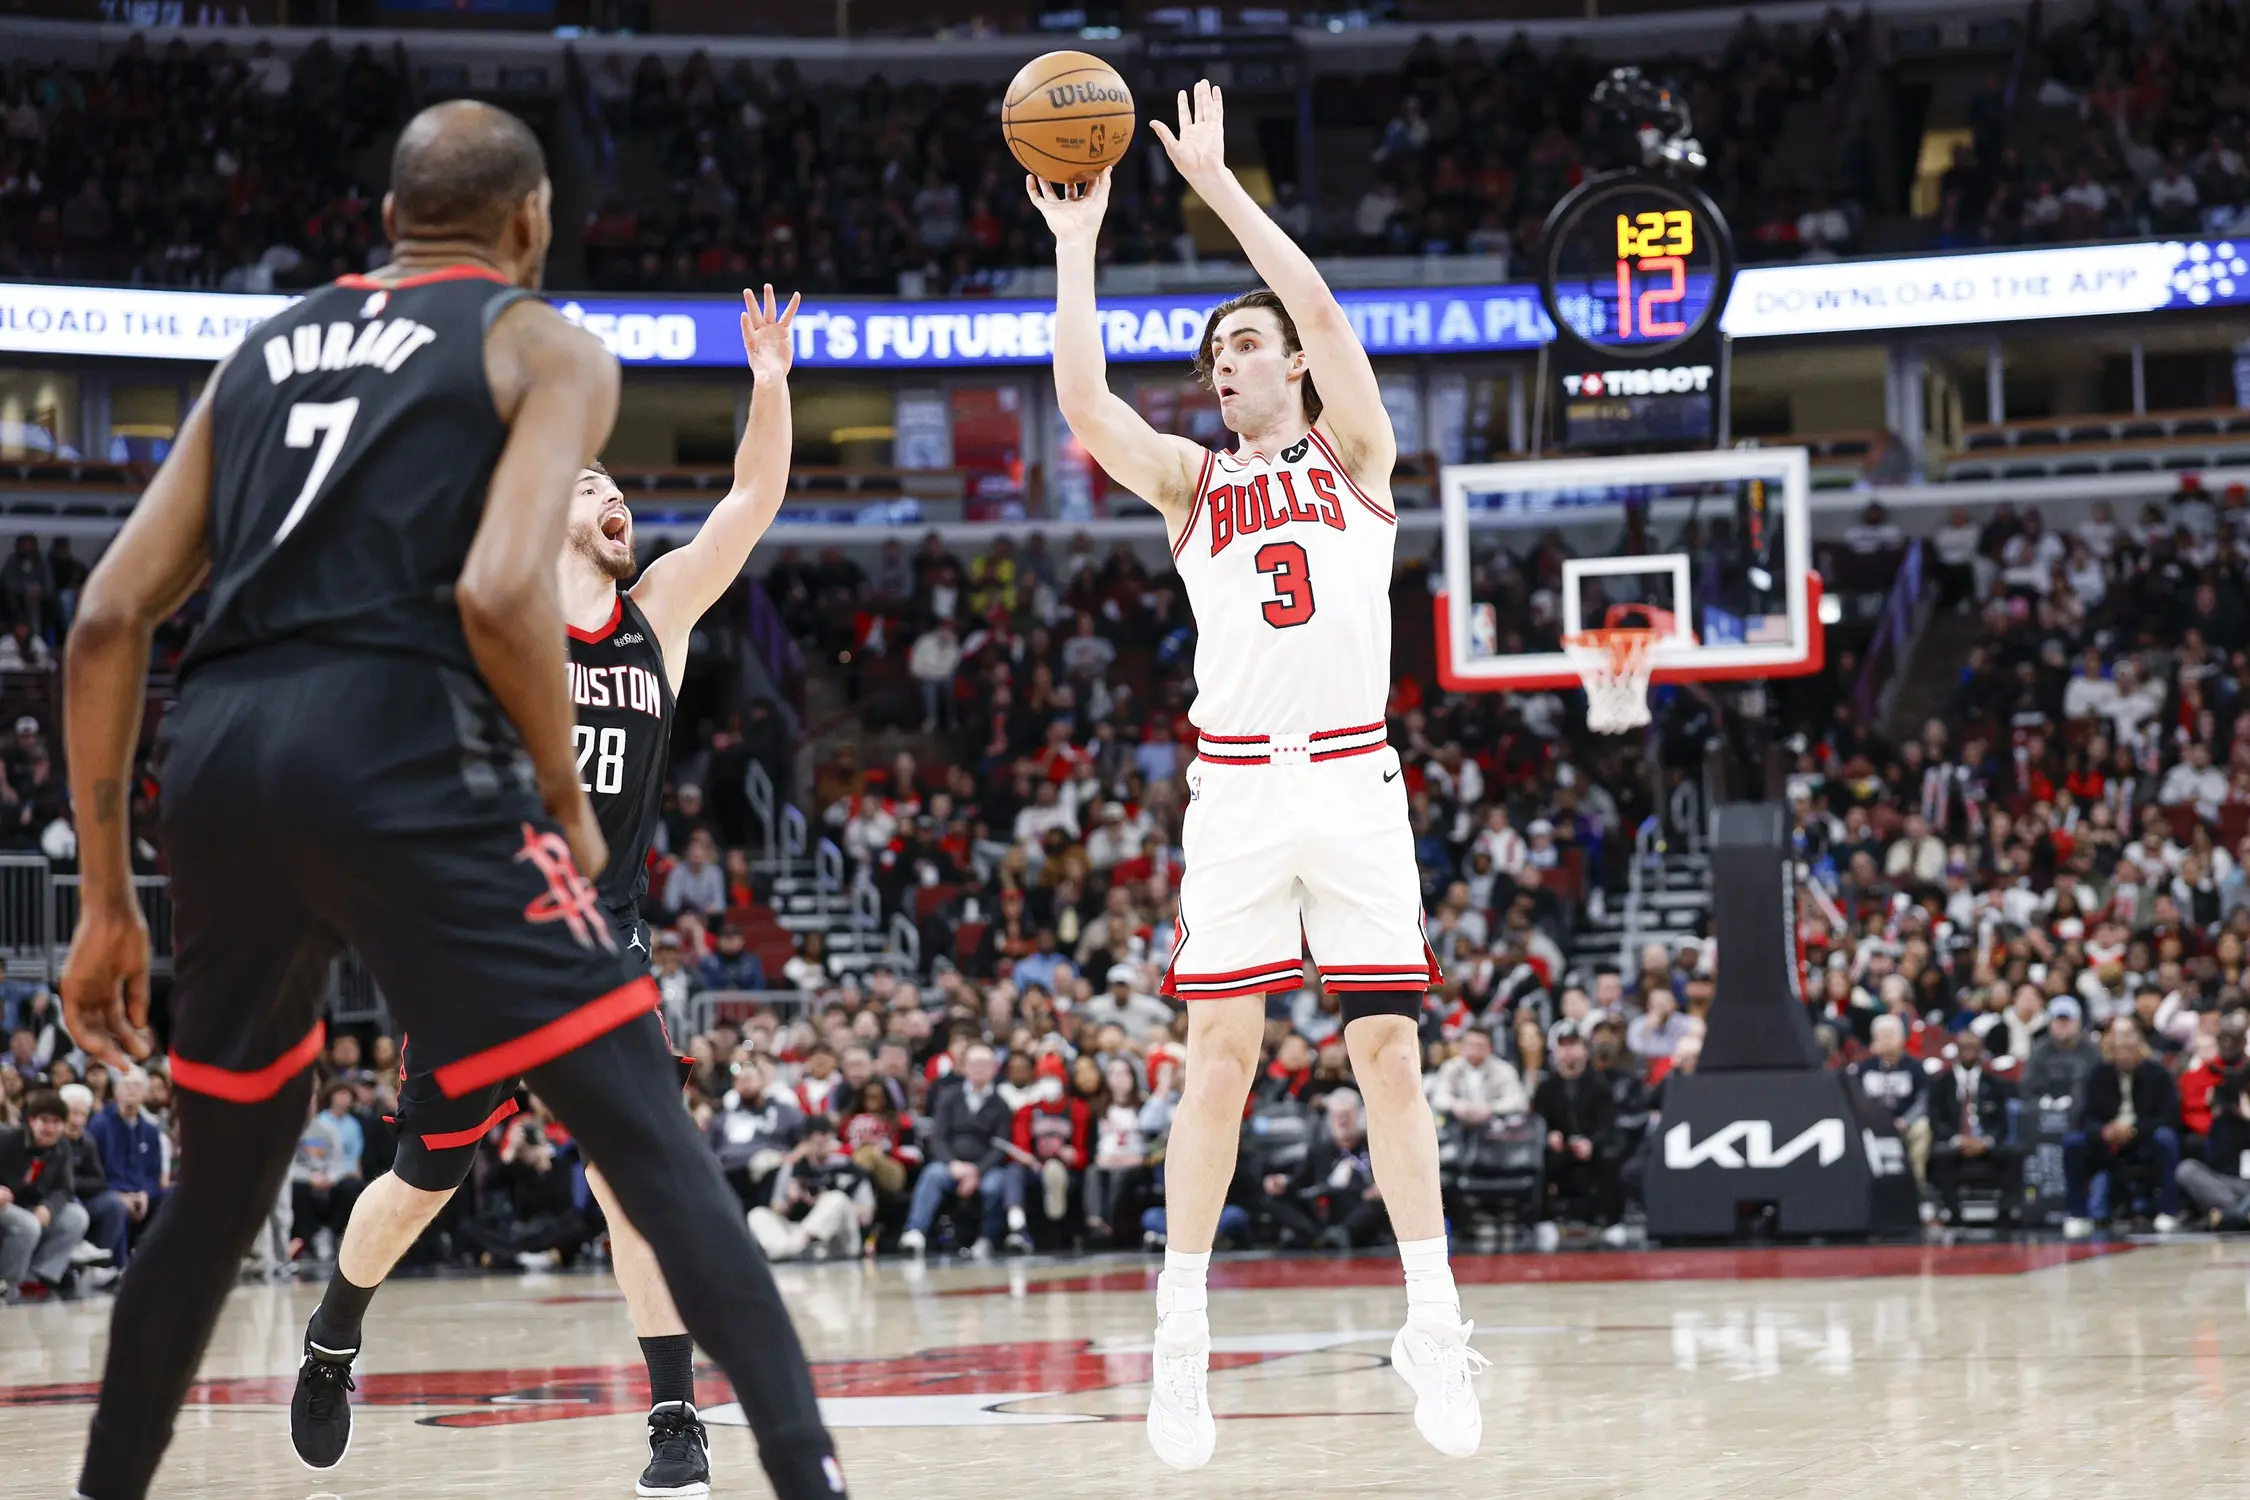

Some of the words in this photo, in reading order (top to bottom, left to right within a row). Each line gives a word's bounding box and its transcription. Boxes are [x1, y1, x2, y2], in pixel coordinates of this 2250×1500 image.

[1047, 81, 1130, 109] Wilson
[1617, 210, 1693, 259] 1:23
[1617, 256, 1687, 338] 12
[1755, 277, 1976, 314] DOWNLOAD
[1992, 273, 2050, 298] THE
[2069, 267, 2138, 295] APP
[0, 305, 107, 333] LOAD
[122, 311, 181, 337] THE
[866, 311, 1057, 360] FUTURE
[1342, 300, 1432, 346] ITH
[1438, 300, 1479, 344] A
[264, 318, 437, 385] DURANT
[1603, 366, 1713, 396] TISSOT
[271, 397, 360, 548] 7
[1207, 468, 1346, 558] BULLS
[1254, 541, 1316, 629] 3
[1664, 1118, 1845, 1169] KIA
